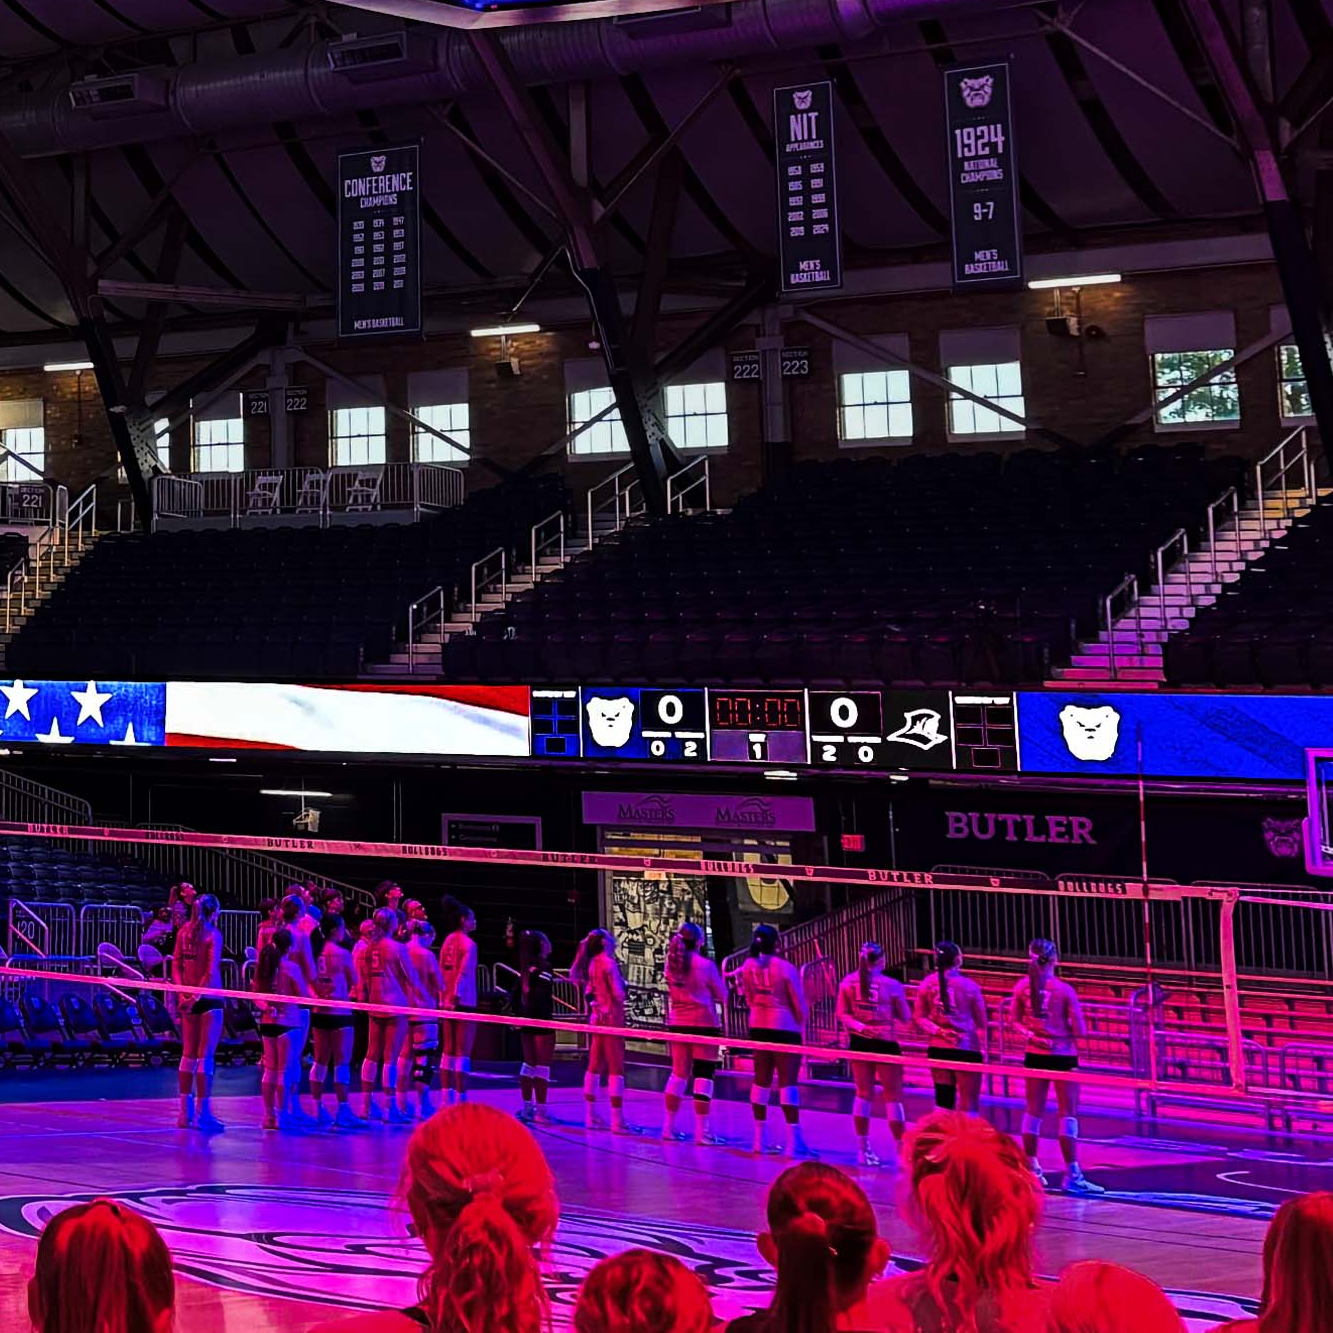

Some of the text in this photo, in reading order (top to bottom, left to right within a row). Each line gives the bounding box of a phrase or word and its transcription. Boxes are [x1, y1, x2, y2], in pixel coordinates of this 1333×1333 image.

[789, 112, 820, 142] NIT
[954, 123, 1006, 159] 1924
[344, 172, 414, 198] CONFERENCE
[973, 201, 995, 221] 9-7
[964, 260, 1010, 275] BASKETBALL
[733, 364, 760, 379] 222
[782, 360, 809, 375] 223
[250, 401, 268, 415] 221
[286, 397, 308, 411] 222
[22, 494, 42, 508] 221
[657, 694, 683, 724] 0
[716, 697, 801, 726] 00:00
[830, 697, 858, 728] 0
[650, 740, 698, 757] 0 2
[752, 743, 763, 760] 1
[821, 745, 874, 763] 2 0
[944, 811, 1098, 846] BUTLER
[267, 838, 314, 850] BUTLER
[867, 869, 933, 885] BUTLER
[1057, 880, 1122, 895] BULLDOGS
